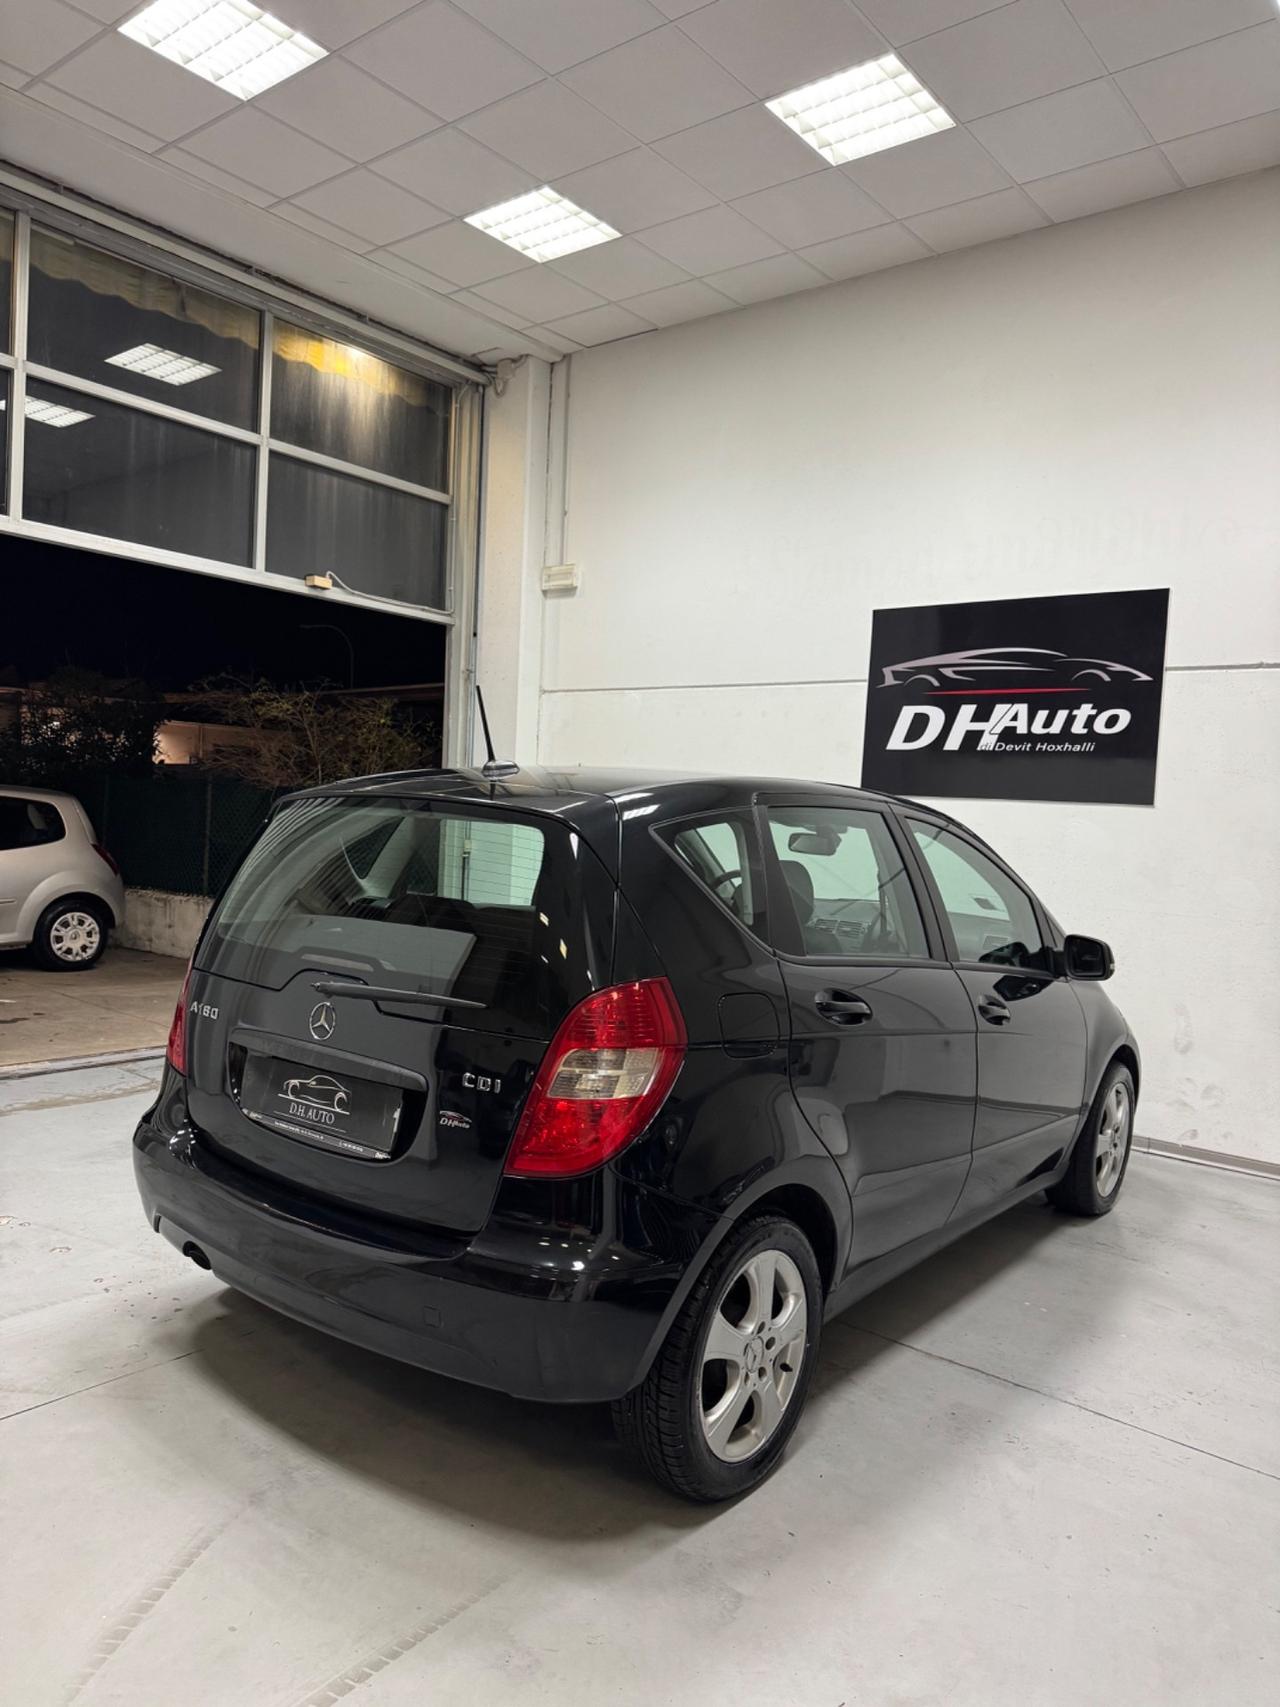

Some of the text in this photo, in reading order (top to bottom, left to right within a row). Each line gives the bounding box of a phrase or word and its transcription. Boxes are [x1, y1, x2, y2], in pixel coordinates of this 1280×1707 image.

[995, 742, 1032, 752] Devit
[1035, 742, 1096, 752] Hoxhalli
[463, 1072, 501, 1093] CDI
[307, 1108, 335, 1125] AUTO
